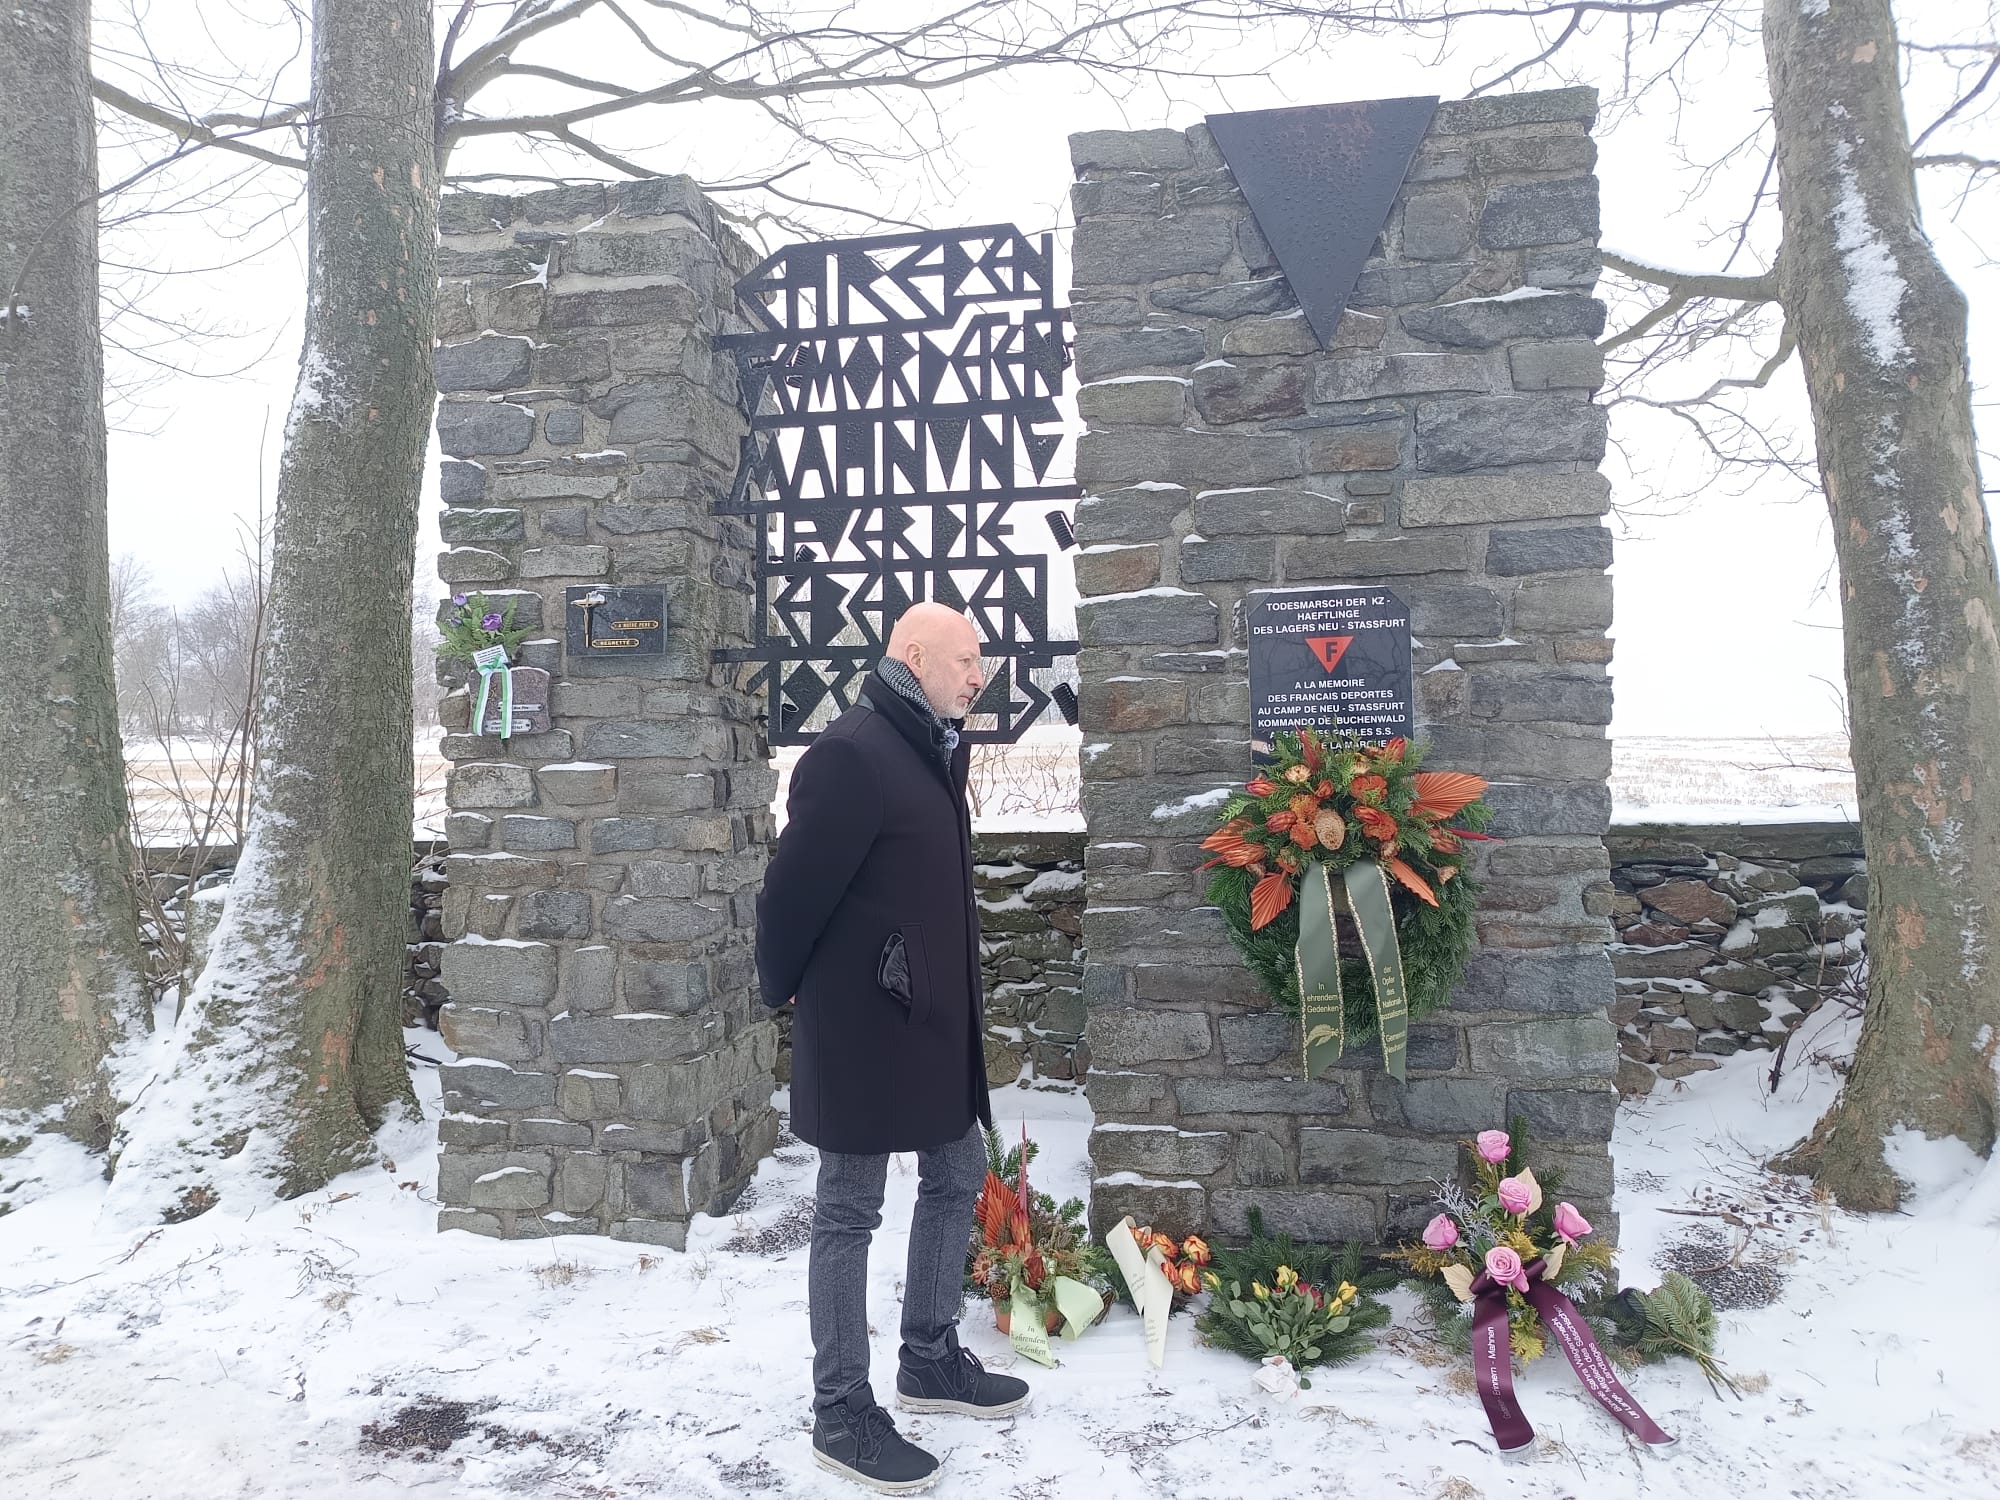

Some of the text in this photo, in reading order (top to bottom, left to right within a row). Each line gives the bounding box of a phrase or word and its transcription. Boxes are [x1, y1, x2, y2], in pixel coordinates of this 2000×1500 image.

[1266, 599, 1343, 611] TODESMARSCH
[1346, 598, 1366, 607] DER
[1372, 597, 1384, 605] KZ
[1298, 610, 1360, 621] HAEFTLINGE
[1253, 626, 1273, 635] DES
[1276, 623, 1315, 633] LAGERS
[1318, 622, 1338, 631] NEU
[1348, 619, 1405, 630] STASSFURT
[1325, 642, 1338, 662] F
[1295, 679, 1365, 689] A LA MEMOIRE
[1268, 690, 1393, 702] DES FRANCAIS DEPORTES
[1258, 706, 1271, 715] AU
[1274, 705, 1301, 714] CAMP
[1304, 705, 1317, 713] DE
[1319, 704, 1339, 712] NEU
[1348, 702, 1404, 712] STASSFURT
[1258, 714, 1405, 727] KOMMANDO DE BUCHENWALD
[1355, 728, 1373, 736] LES
[1376, 727, 1394, 736] S.S.
[1318, 982, 1325, 991] In
[1306, 993, 1338, 1002] ehrendem
[1306, 1004, 1340, 1013] Gedenken
[1027, 1325, 1035, 1333] In
[1015, 1333, 1046, 1344] ehrendem
[1488, 1326, 1496, 1359] Mahnen
[1552, 1317, 1584, 1368] Wagenknecht
[1015, 1344, 1046, 1356] Gedenken
[1588, 1342, 1616, 1384] Landtages
[1582, 1368, 1599, 1391] Sahra
